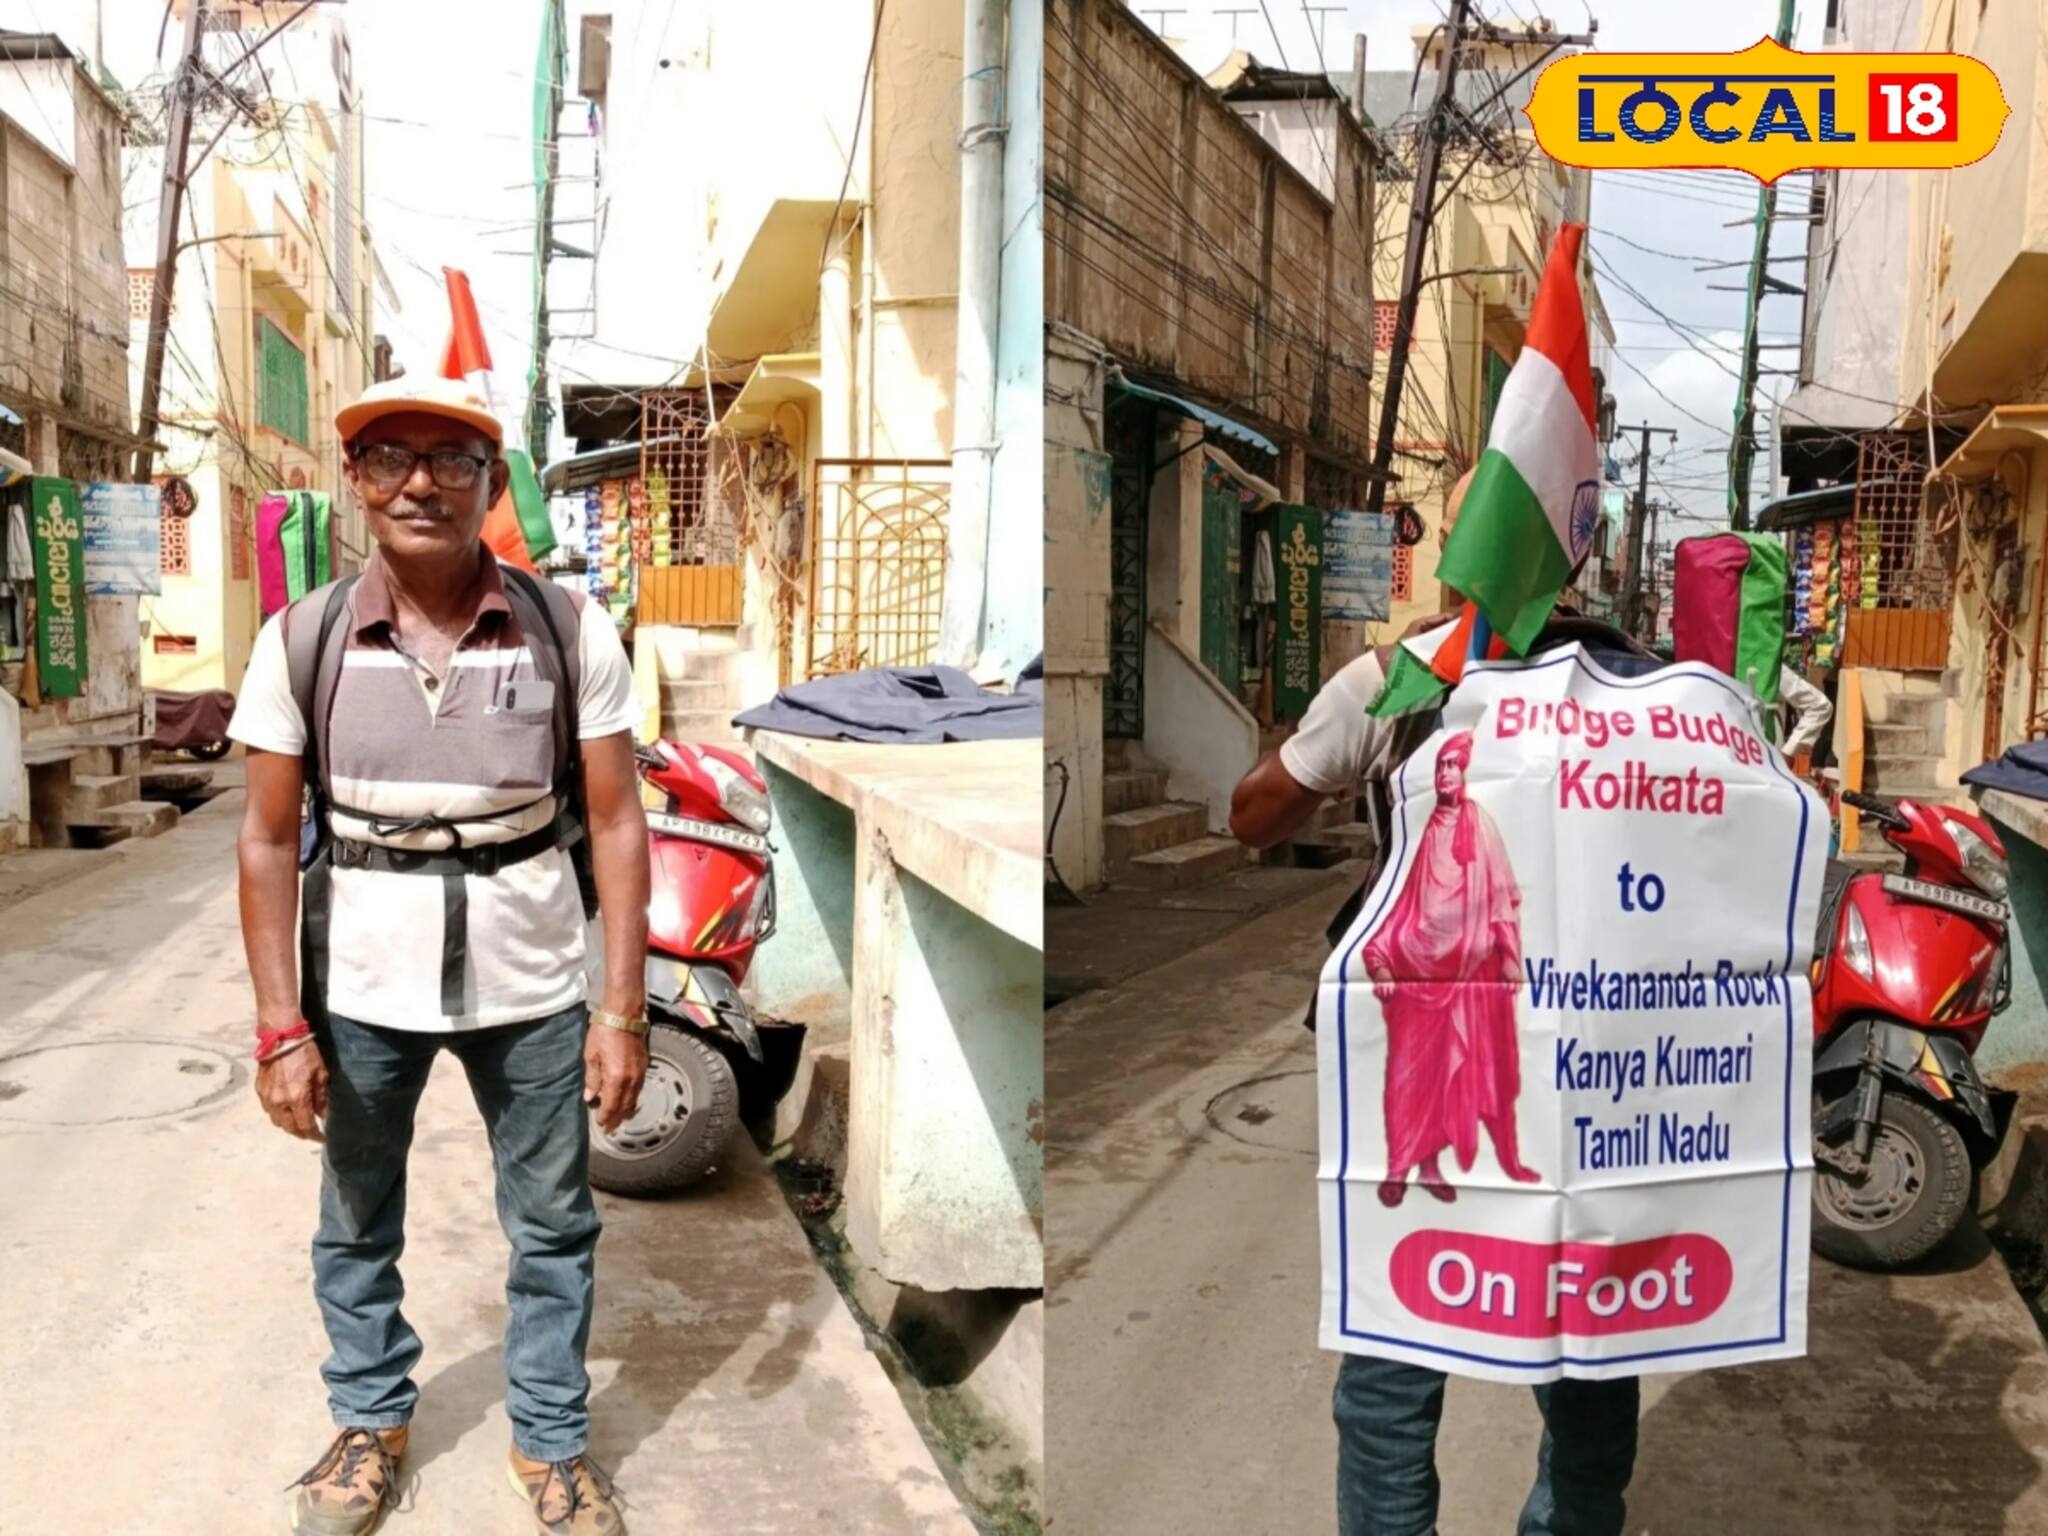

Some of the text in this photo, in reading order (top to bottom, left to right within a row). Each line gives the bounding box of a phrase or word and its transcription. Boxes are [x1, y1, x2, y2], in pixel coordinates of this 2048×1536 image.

[1647, 705, 1764, 766] Budge
[1560, 759, 1725, 815] Kolkata
[1618, 862, 1666, 912] to
[1526, 958, 1782, 1011] Vivekananda Rock
[1556, 1032, 1753, 1103] Kanya Kumari
[1574, 1110, 1730, 1170] Tamil Nadu
[1427, 1250, 1695, 1319] On Foot
